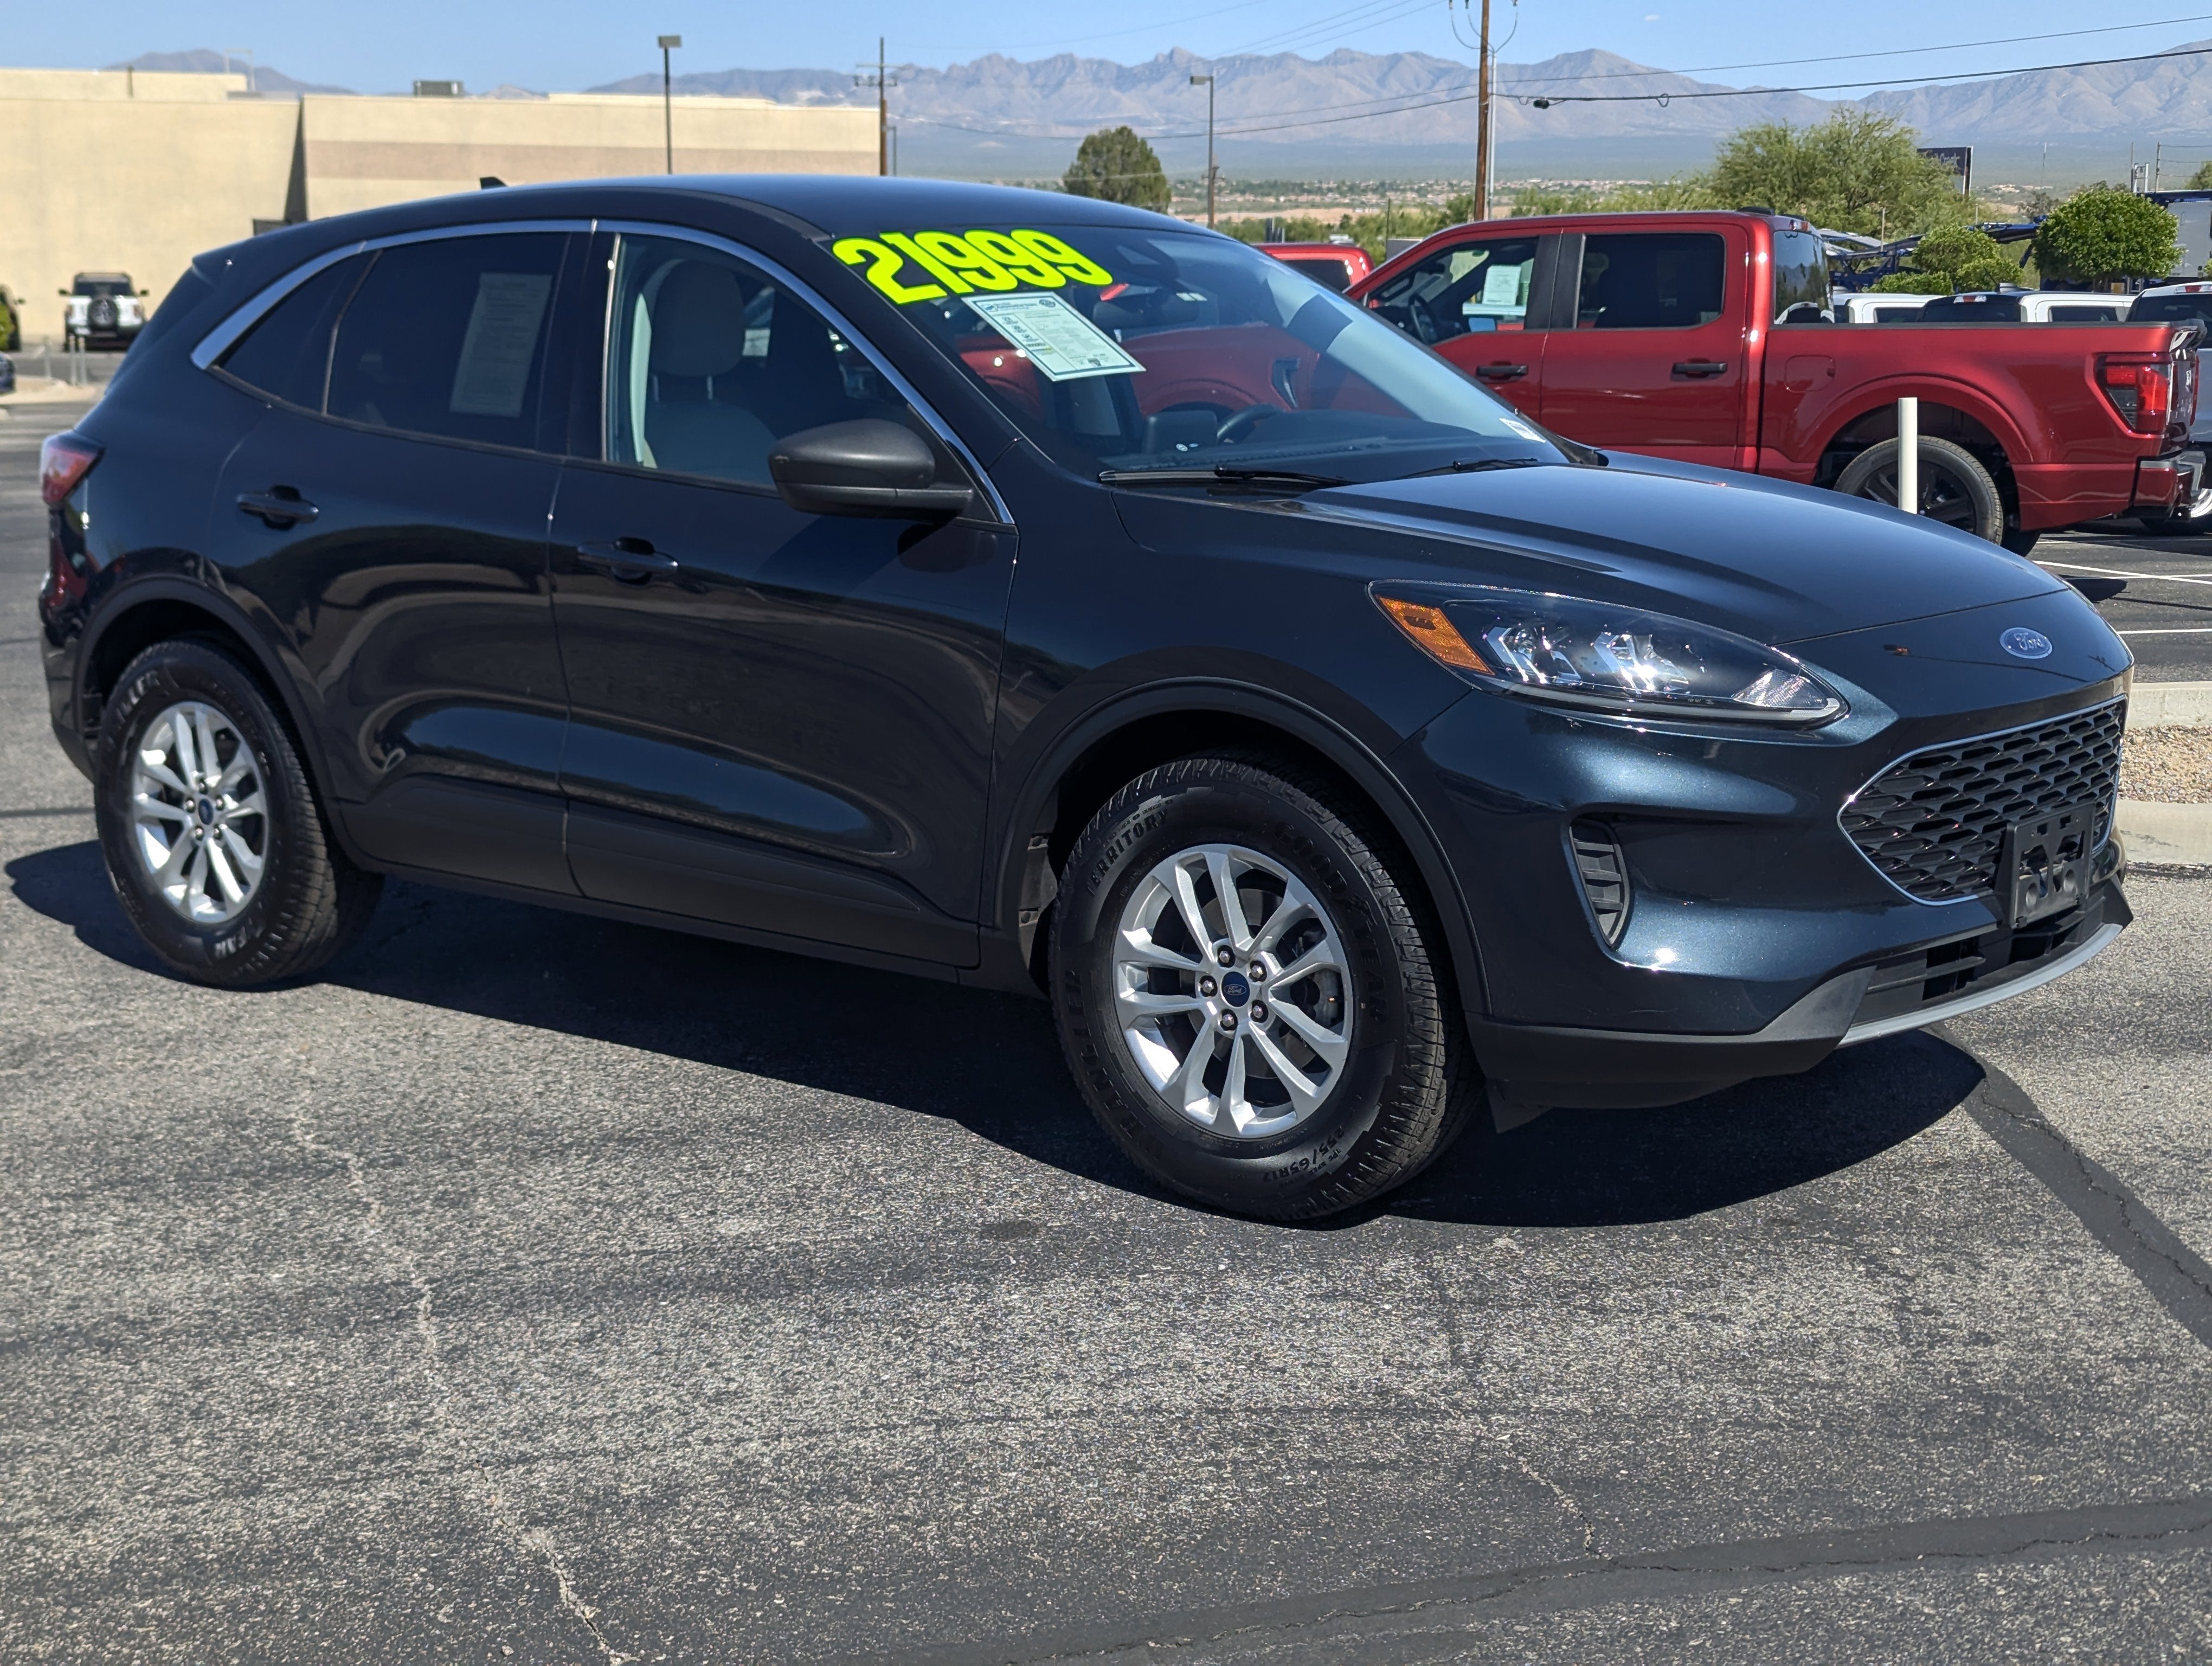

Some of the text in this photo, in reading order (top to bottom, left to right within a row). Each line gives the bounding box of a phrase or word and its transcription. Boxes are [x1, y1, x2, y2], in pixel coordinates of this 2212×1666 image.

[832, 229, 1113, 304] 21999
[1086, 809, 1168, 898] TERRITORY
[1263, 1125, 1345, 1182] 255/65R17
